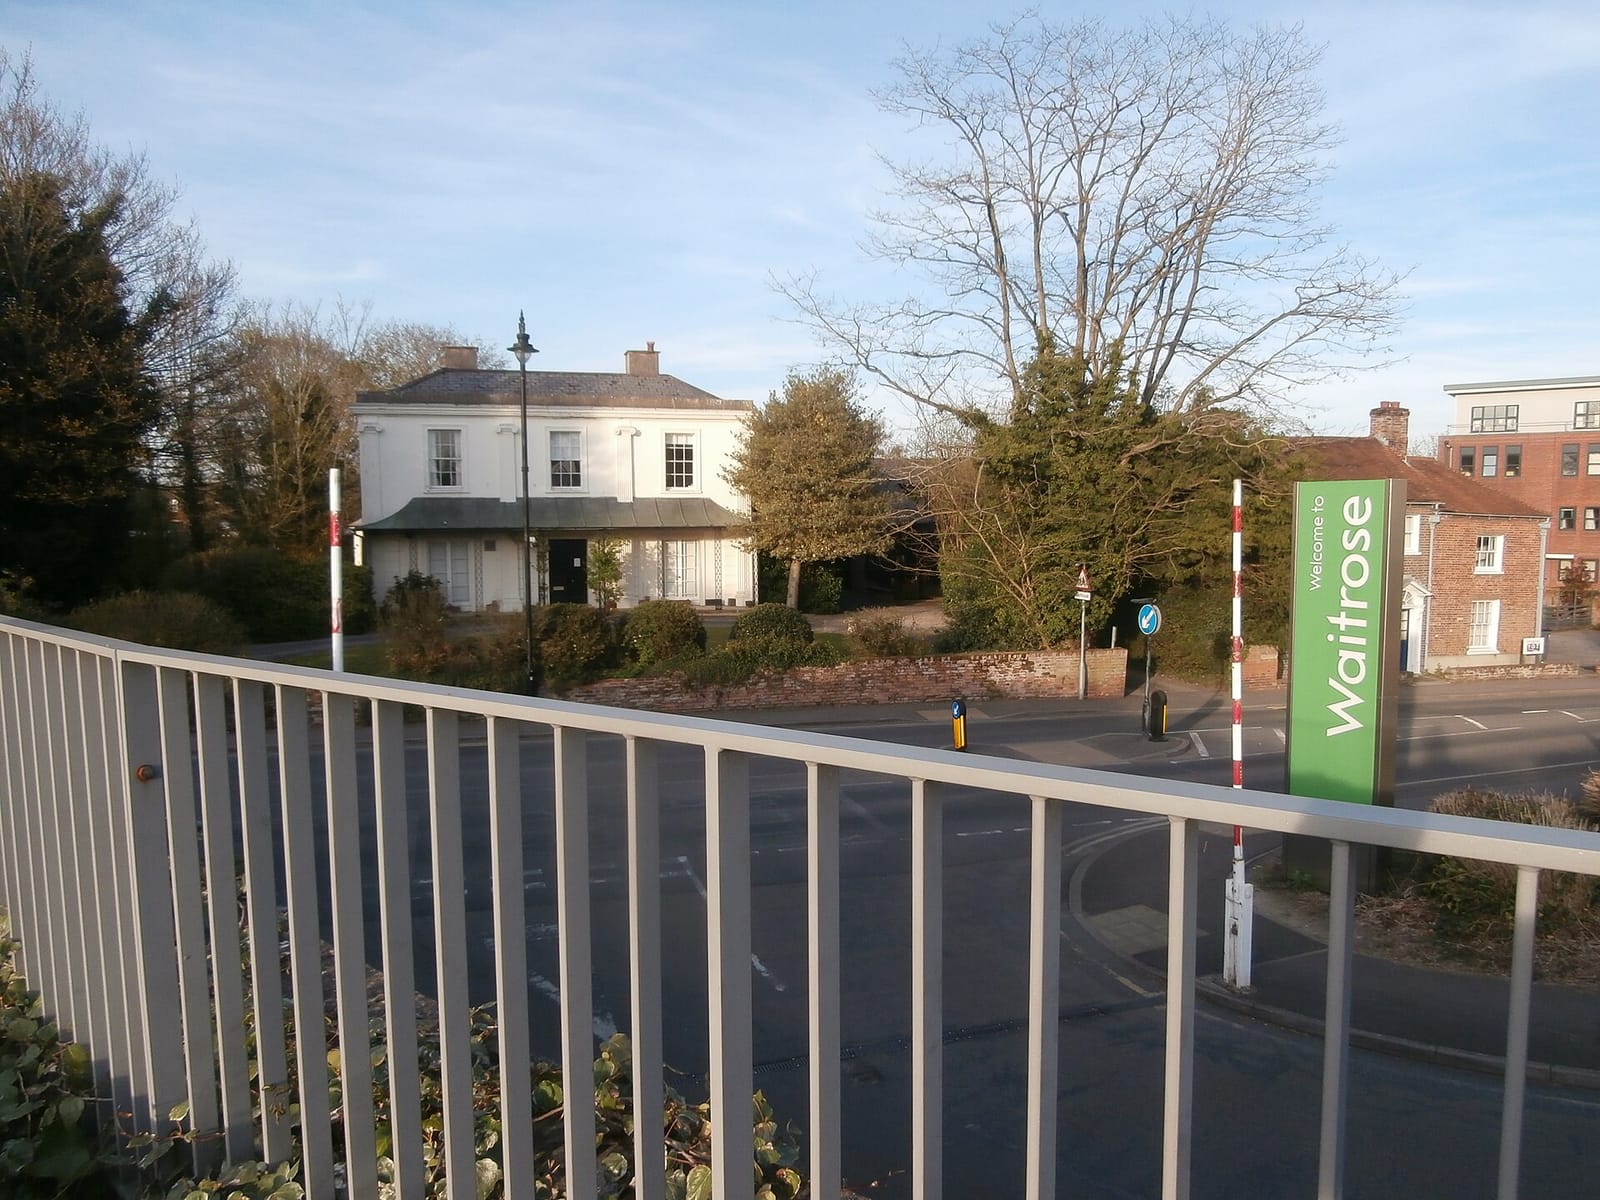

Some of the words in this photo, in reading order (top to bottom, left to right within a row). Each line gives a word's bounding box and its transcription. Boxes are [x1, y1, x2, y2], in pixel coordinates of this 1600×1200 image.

[1312, 495, 1324, 513] to
[1309, 516, 1323, 591] Welcome
[1326, 495, 1372, 737] Waitrose
